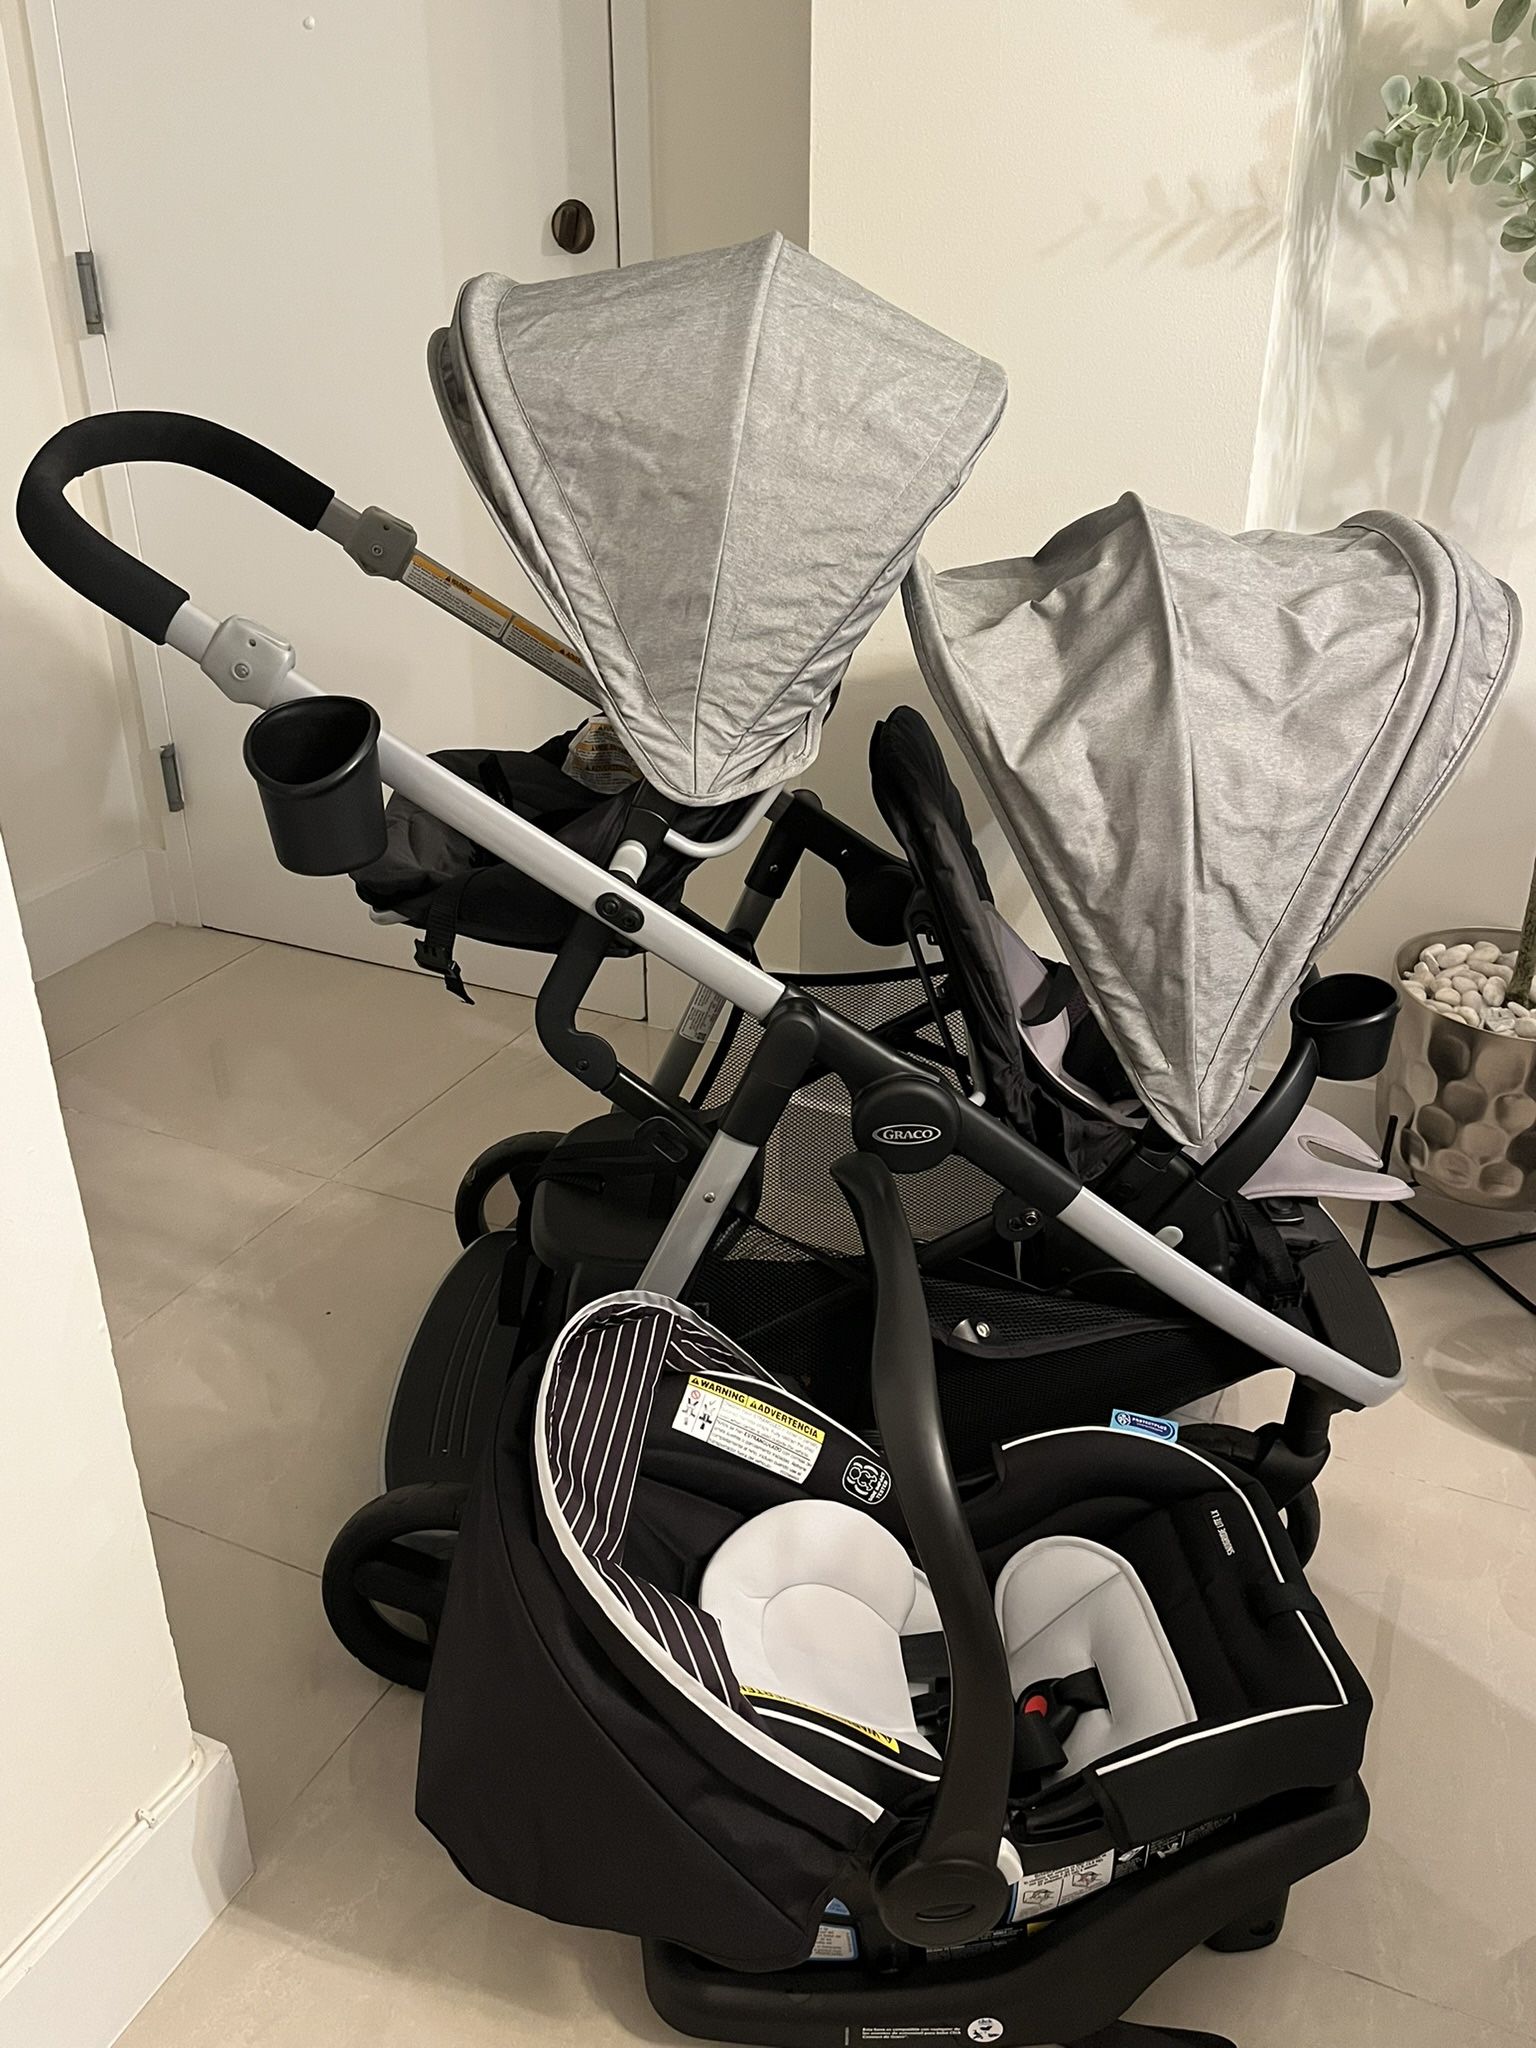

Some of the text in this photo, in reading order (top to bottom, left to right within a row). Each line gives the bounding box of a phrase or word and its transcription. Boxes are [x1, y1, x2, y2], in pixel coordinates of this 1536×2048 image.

[882, 1129, 934, 1140] GRACO
[700, 1379, 746, 1404] WARNING
[757, 1402, 819, 1439] ADVERTENCIA
[1210, 1509, 1220, 1519] LX
